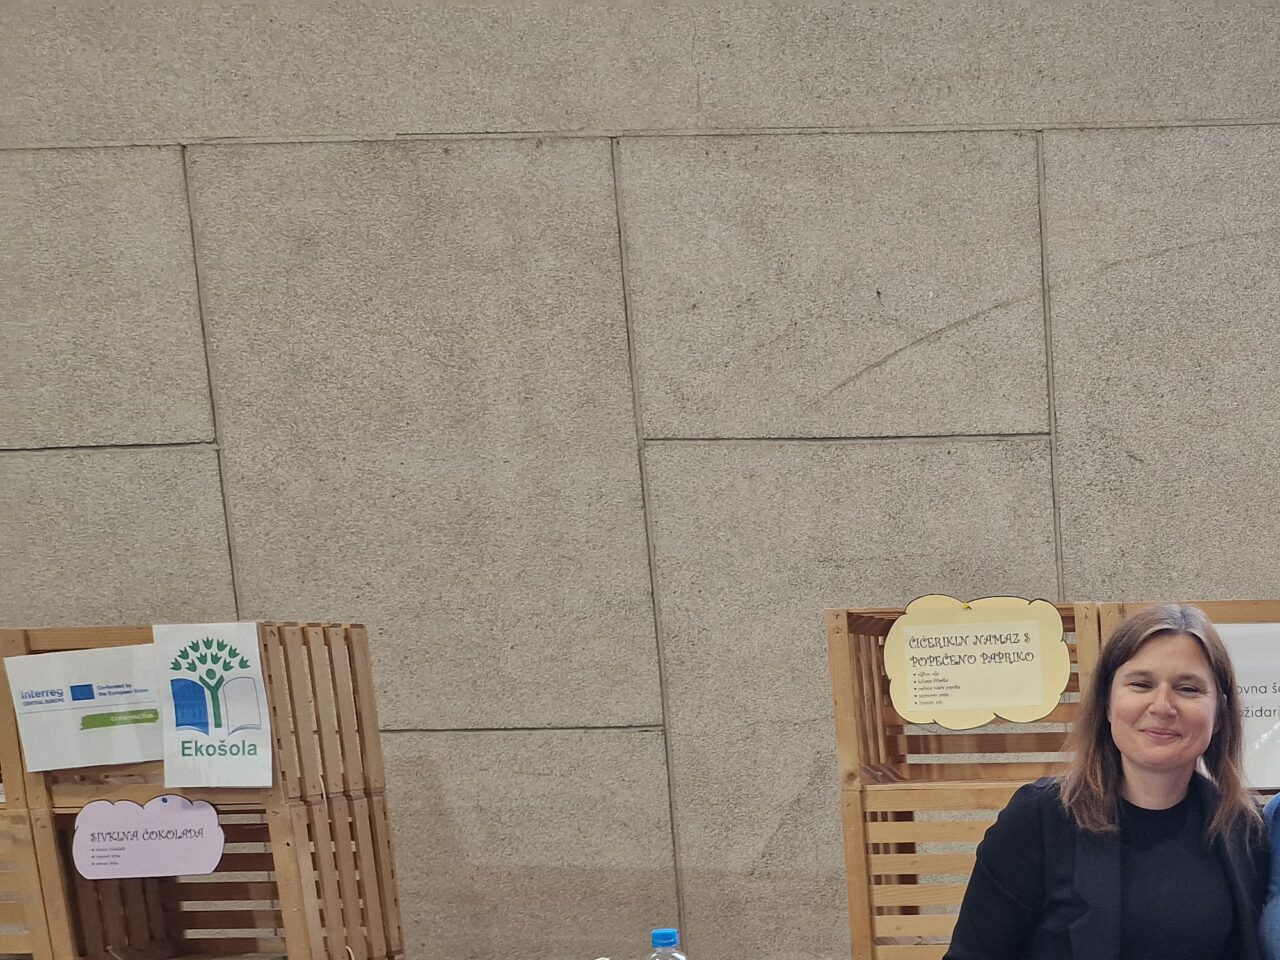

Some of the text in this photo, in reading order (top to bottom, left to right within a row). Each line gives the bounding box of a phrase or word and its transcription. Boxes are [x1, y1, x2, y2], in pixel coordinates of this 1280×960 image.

[908, 632, 1031, 649] ČIČERIKIN NAMAZ S
[909, 651, 1034, 668] POPEČENO PAPRIKO
[1235, 684, 1268, 694] ovna
[181, 740, 258, 758] Ekošola
[90, 827, 204, 842] SIVKINA ČOKOLADA
